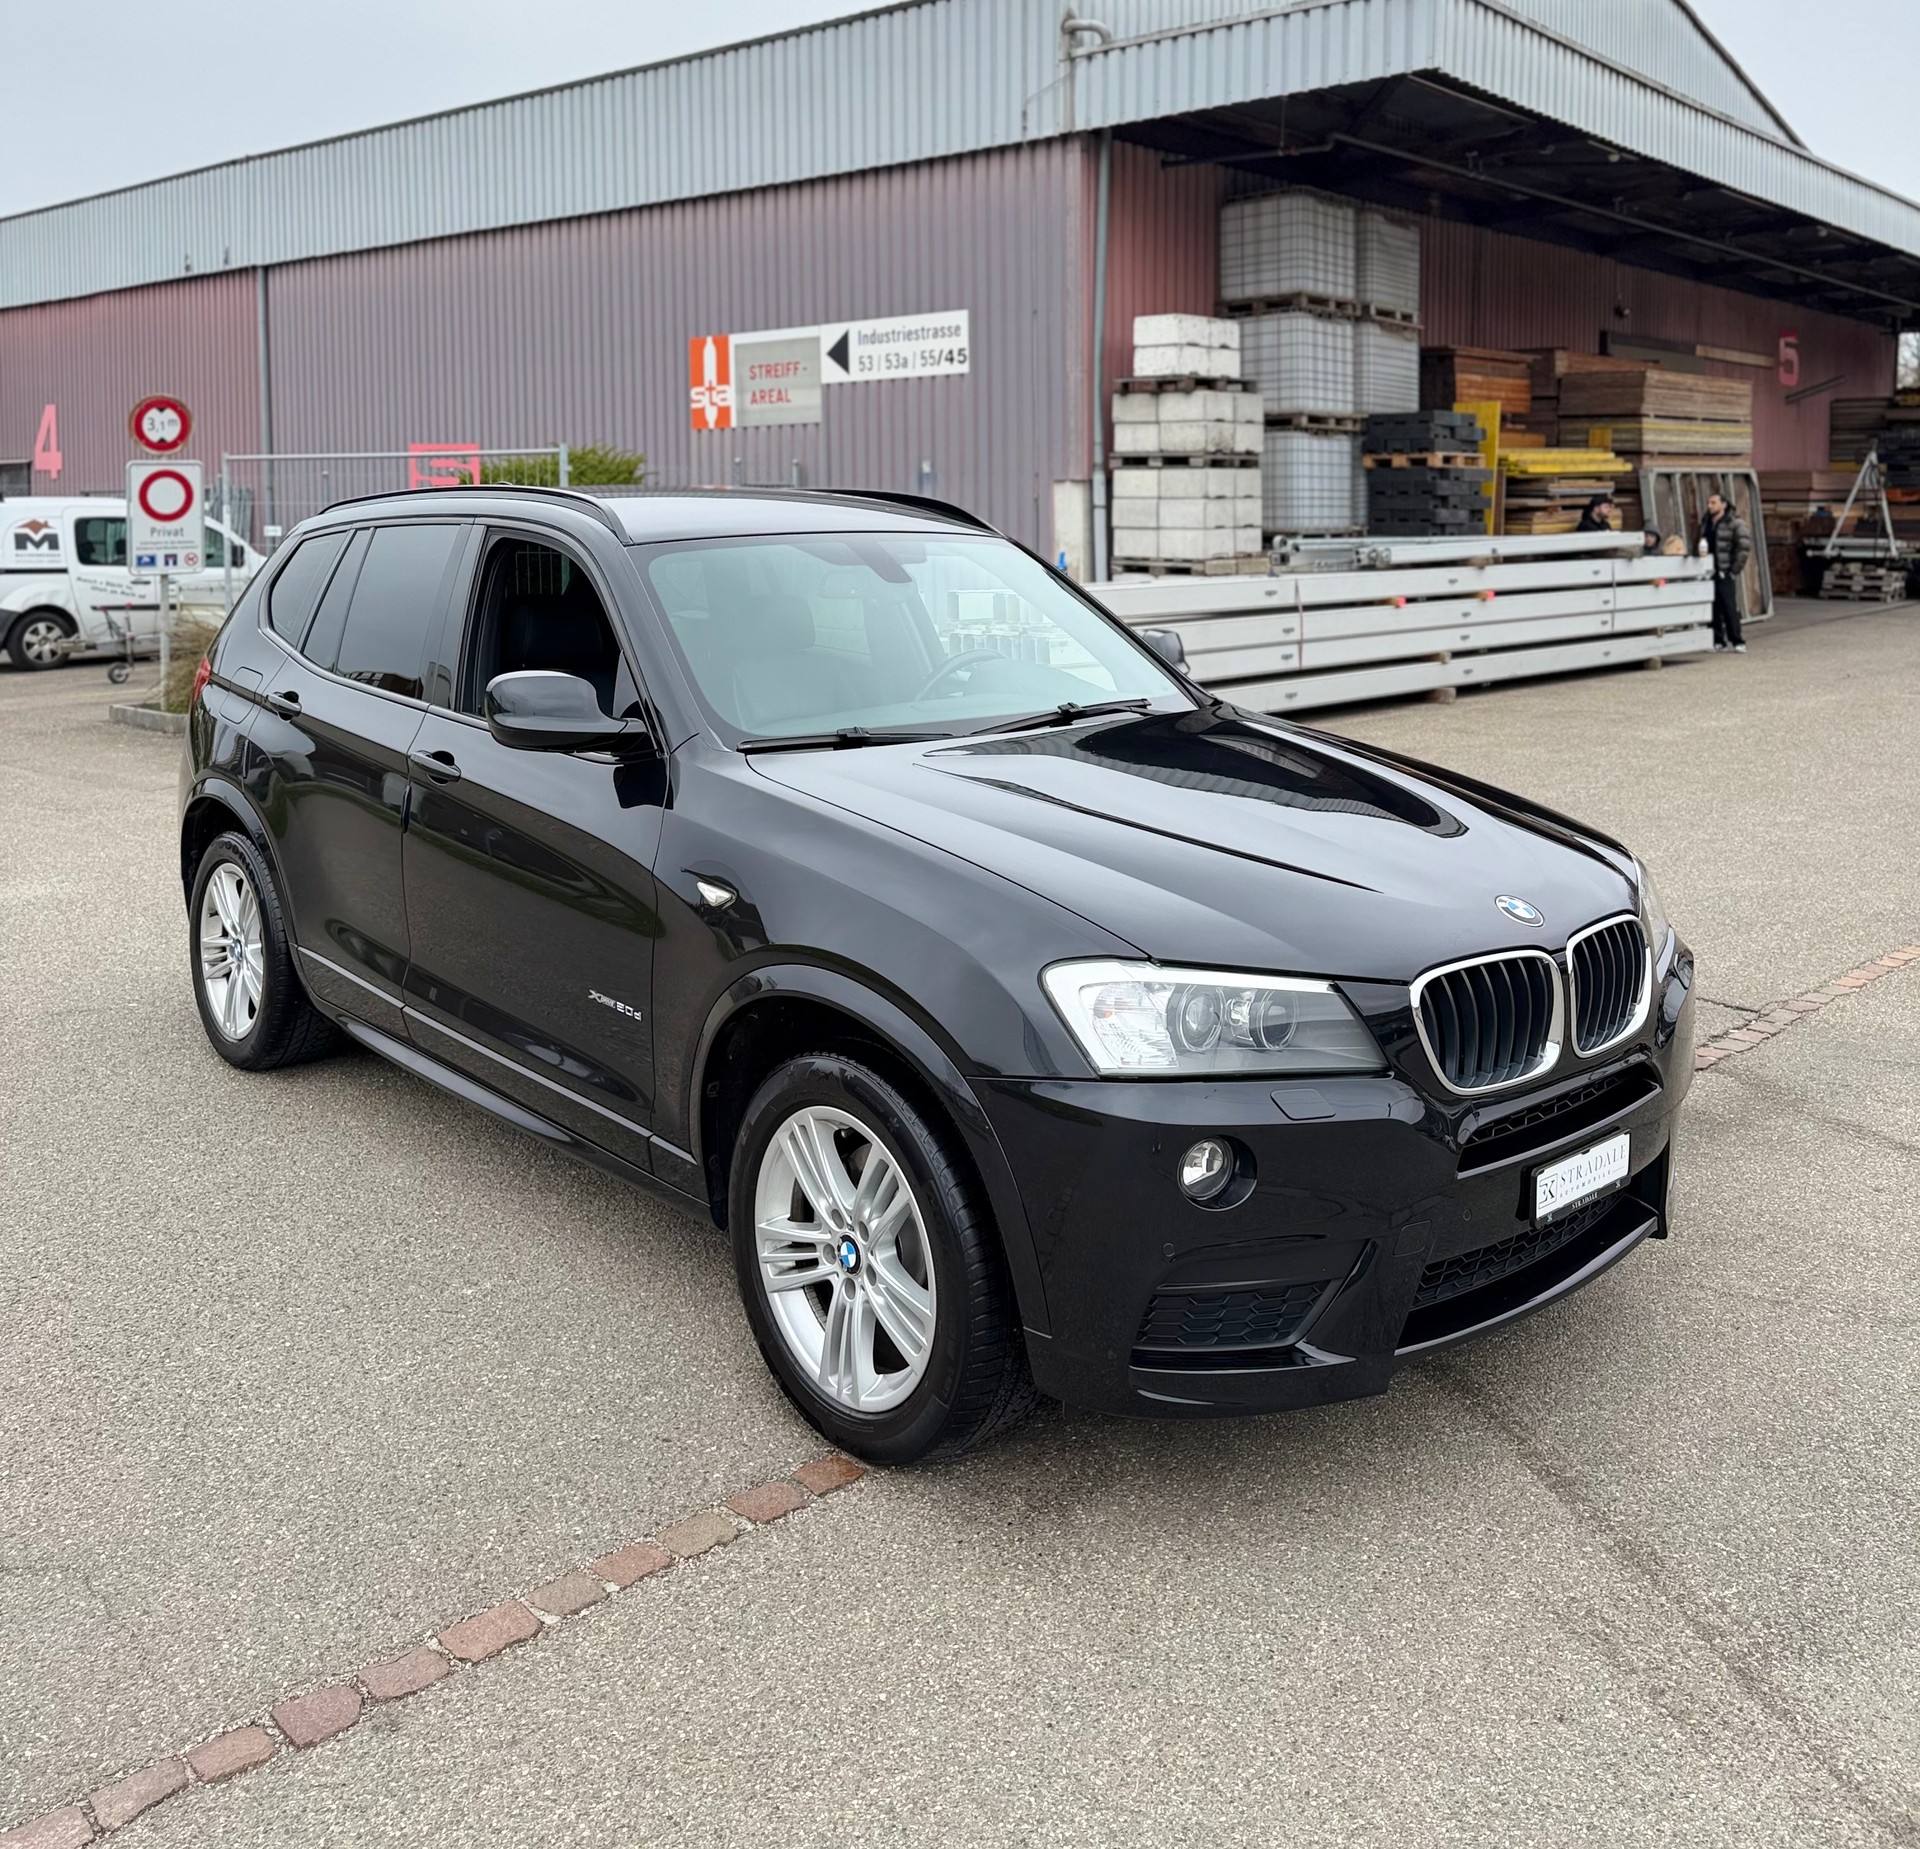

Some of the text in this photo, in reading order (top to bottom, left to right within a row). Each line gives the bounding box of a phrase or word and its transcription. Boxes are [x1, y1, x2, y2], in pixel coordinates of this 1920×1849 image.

[858, 324, 962, 346] Industriestrasse
[858, 354, 874, 372] 53
[885, 352, 908, 370] 53a
[1777, 331, 1800, 387] 5
[750, 388, 792, 406] AREAL
[34, 403, 62, 480] 4
[14, 532, 60, 551] M
[150, 526, 185, 538] Privat
[1560, 1143, 1627, 1188] STRADALE
[1571, 1191, 1599, 1210] STRADALE
